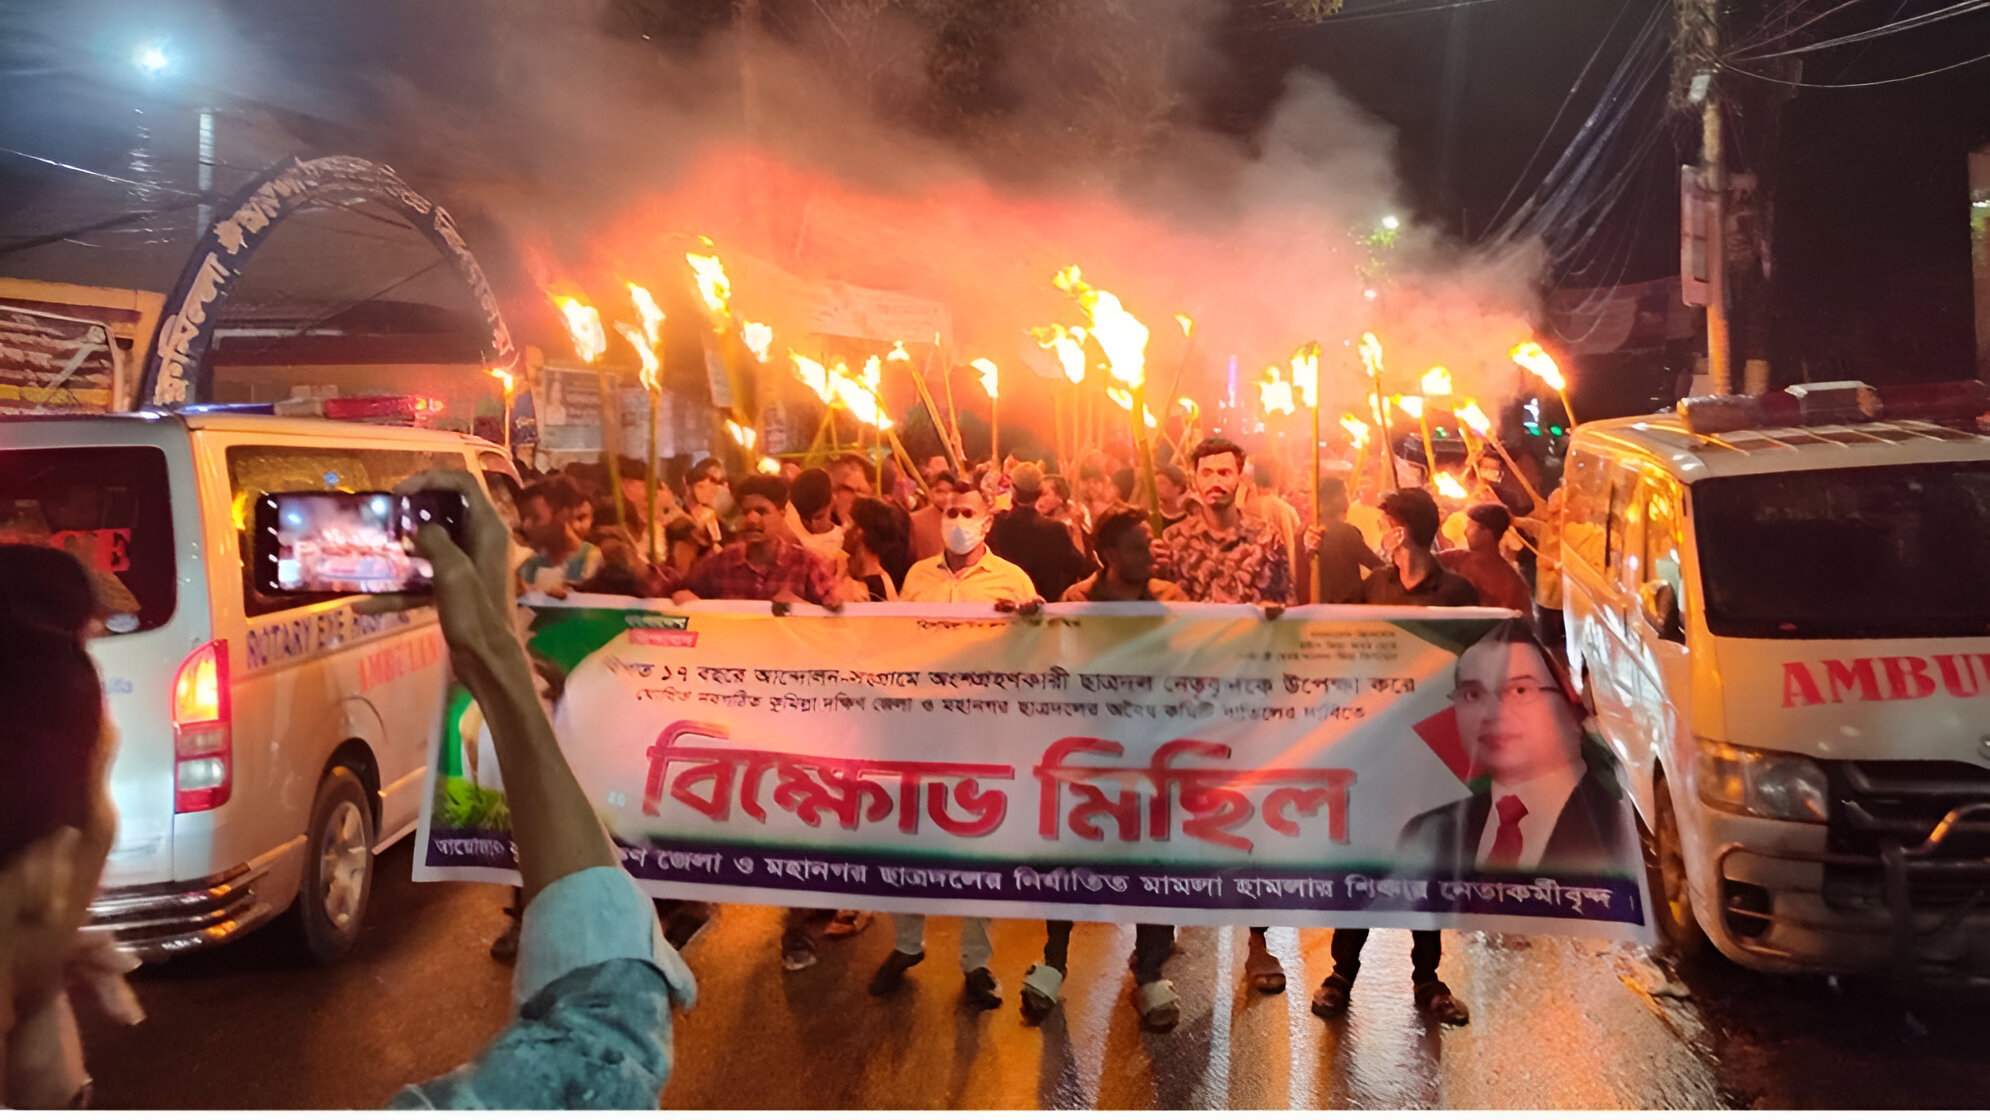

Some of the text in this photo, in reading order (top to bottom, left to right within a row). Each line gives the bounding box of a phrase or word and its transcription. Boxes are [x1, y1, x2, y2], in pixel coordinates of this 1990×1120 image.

[357, 627, 443, 694] AMBULAN
[661, 664, 687, 682] ১৭
[1370, 677, 1416, 695] করে
[642, 719, 1358, 853] বিক্ষোভ মিছিল
